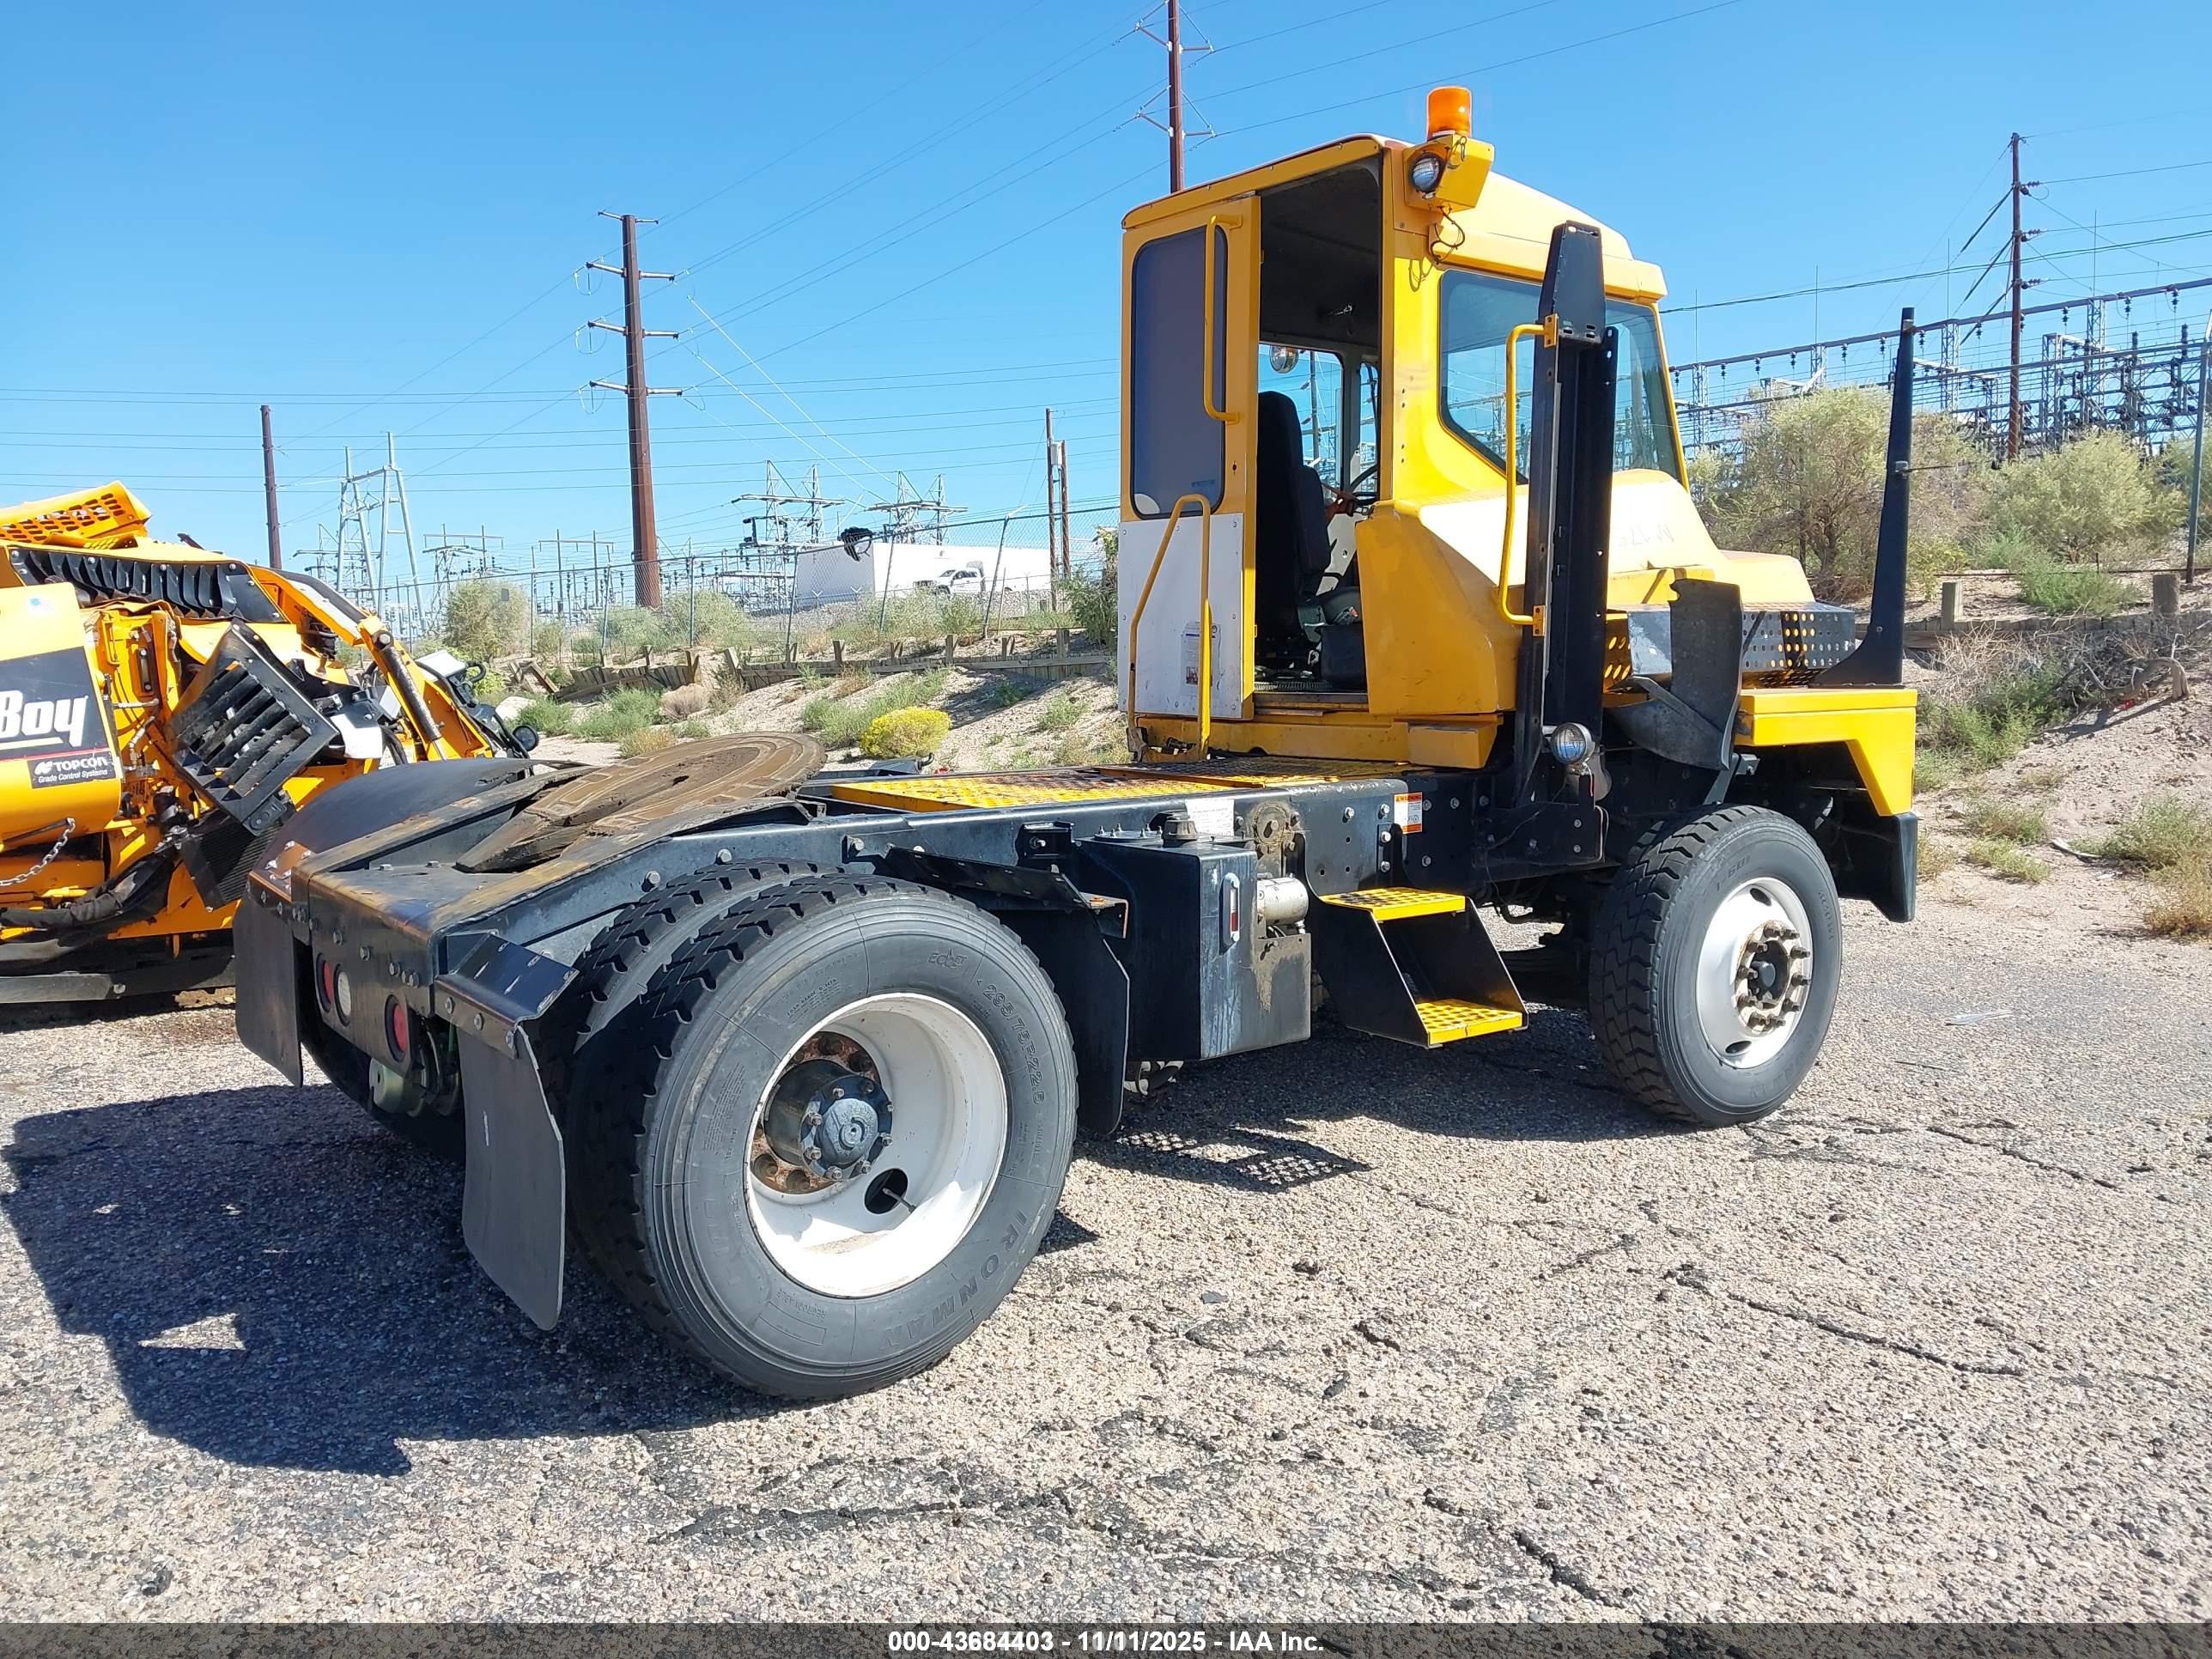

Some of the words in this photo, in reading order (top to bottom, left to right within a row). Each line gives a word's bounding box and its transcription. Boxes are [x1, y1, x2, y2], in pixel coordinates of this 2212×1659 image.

[39, 775, 57, 783] Grade
[58, 771, 81, 781] Control
[82, 769, 107, 779] Systems
[982, 984, 1045, 1105] 295/75R22.5
